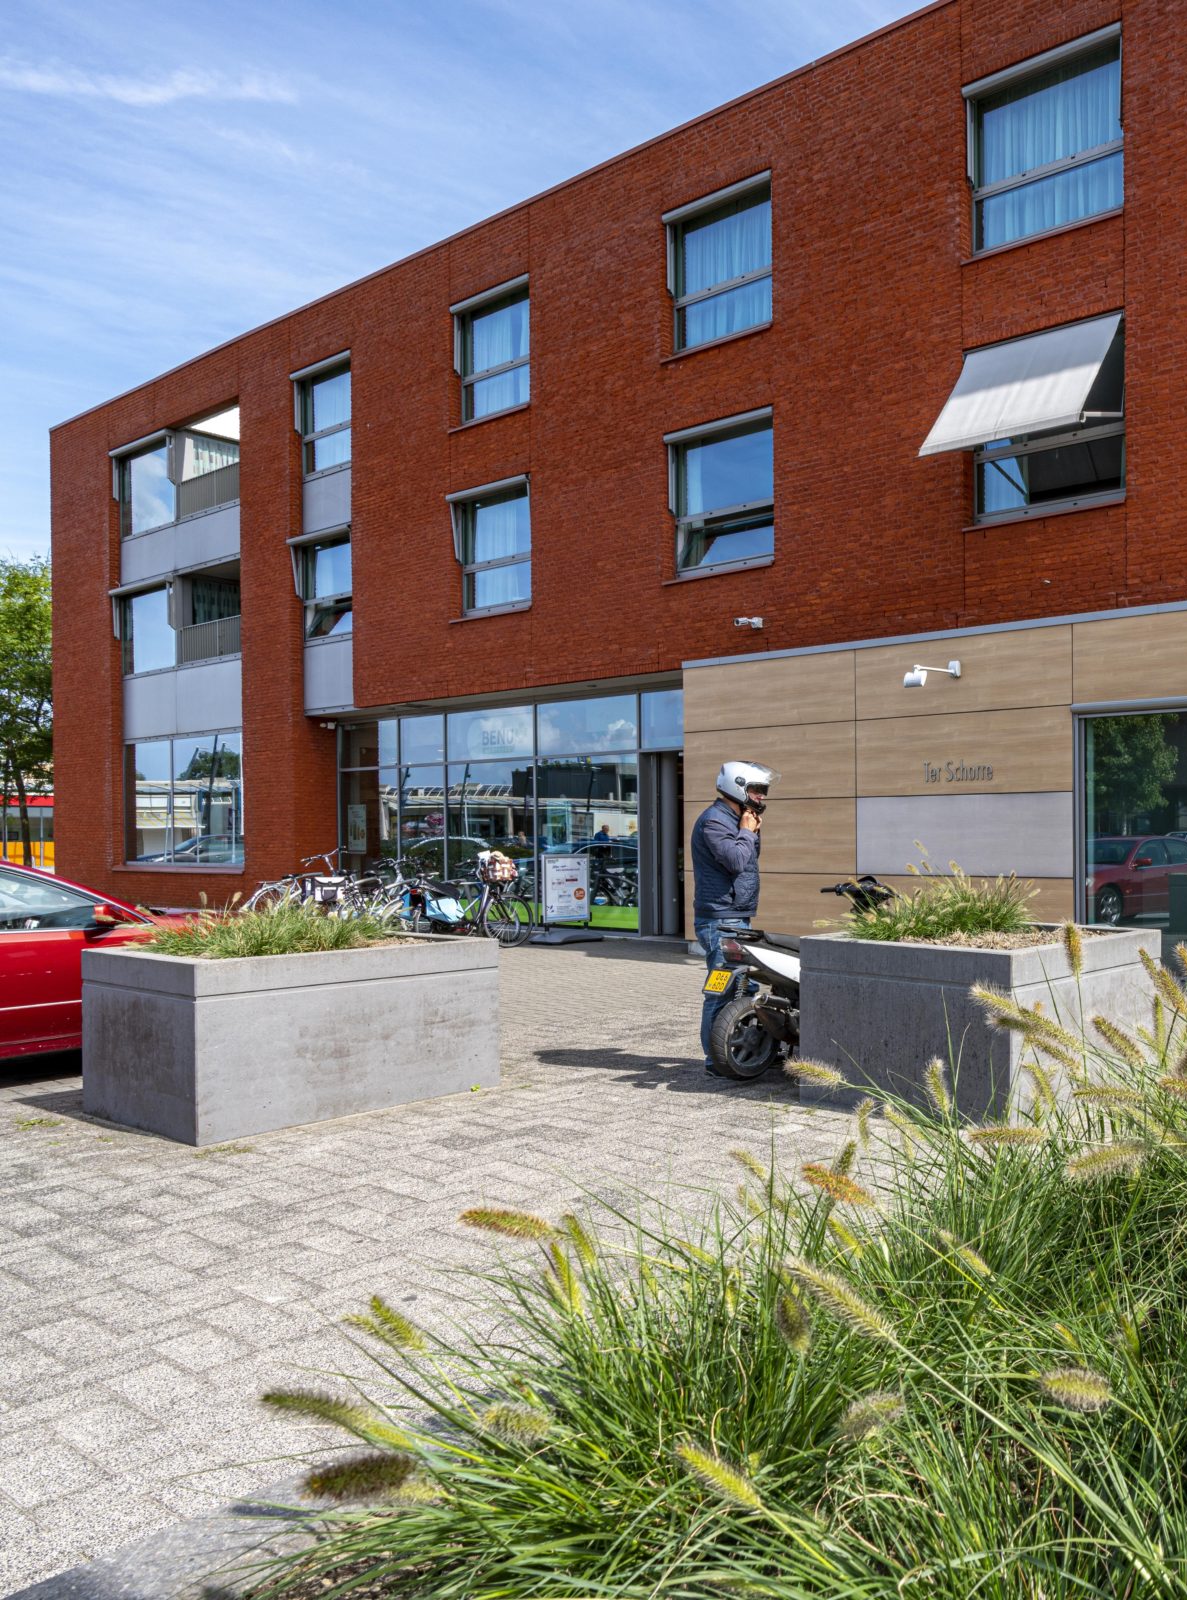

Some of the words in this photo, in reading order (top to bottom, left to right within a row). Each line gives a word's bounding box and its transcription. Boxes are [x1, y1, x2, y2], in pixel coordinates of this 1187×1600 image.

[481, 728, 514, 746] BENU
[923, 760, 941, 783] Ter
[944, 759, 994, 783] Schorre
